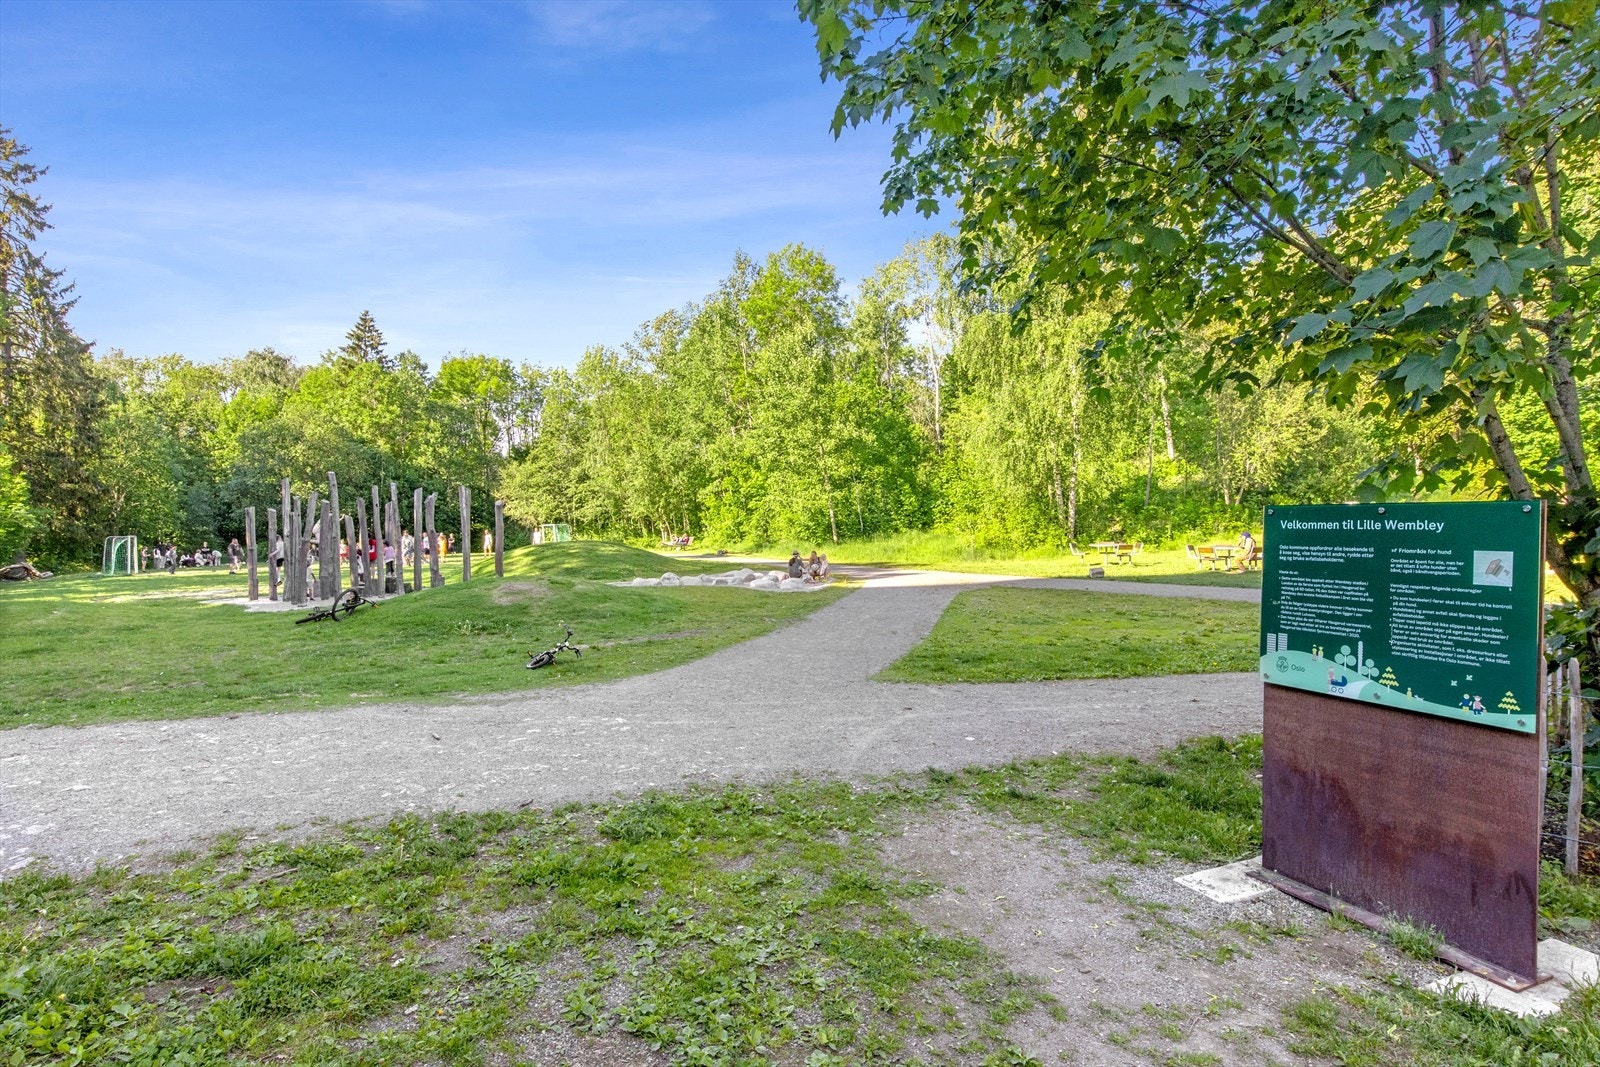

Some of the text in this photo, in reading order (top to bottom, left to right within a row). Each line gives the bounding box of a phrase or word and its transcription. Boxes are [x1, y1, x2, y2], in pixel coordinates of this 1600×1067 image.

[1280, 519, 1444, 533] Velkommen til Lille Wembley
[1291, 663, 1306, 673] Oslo
